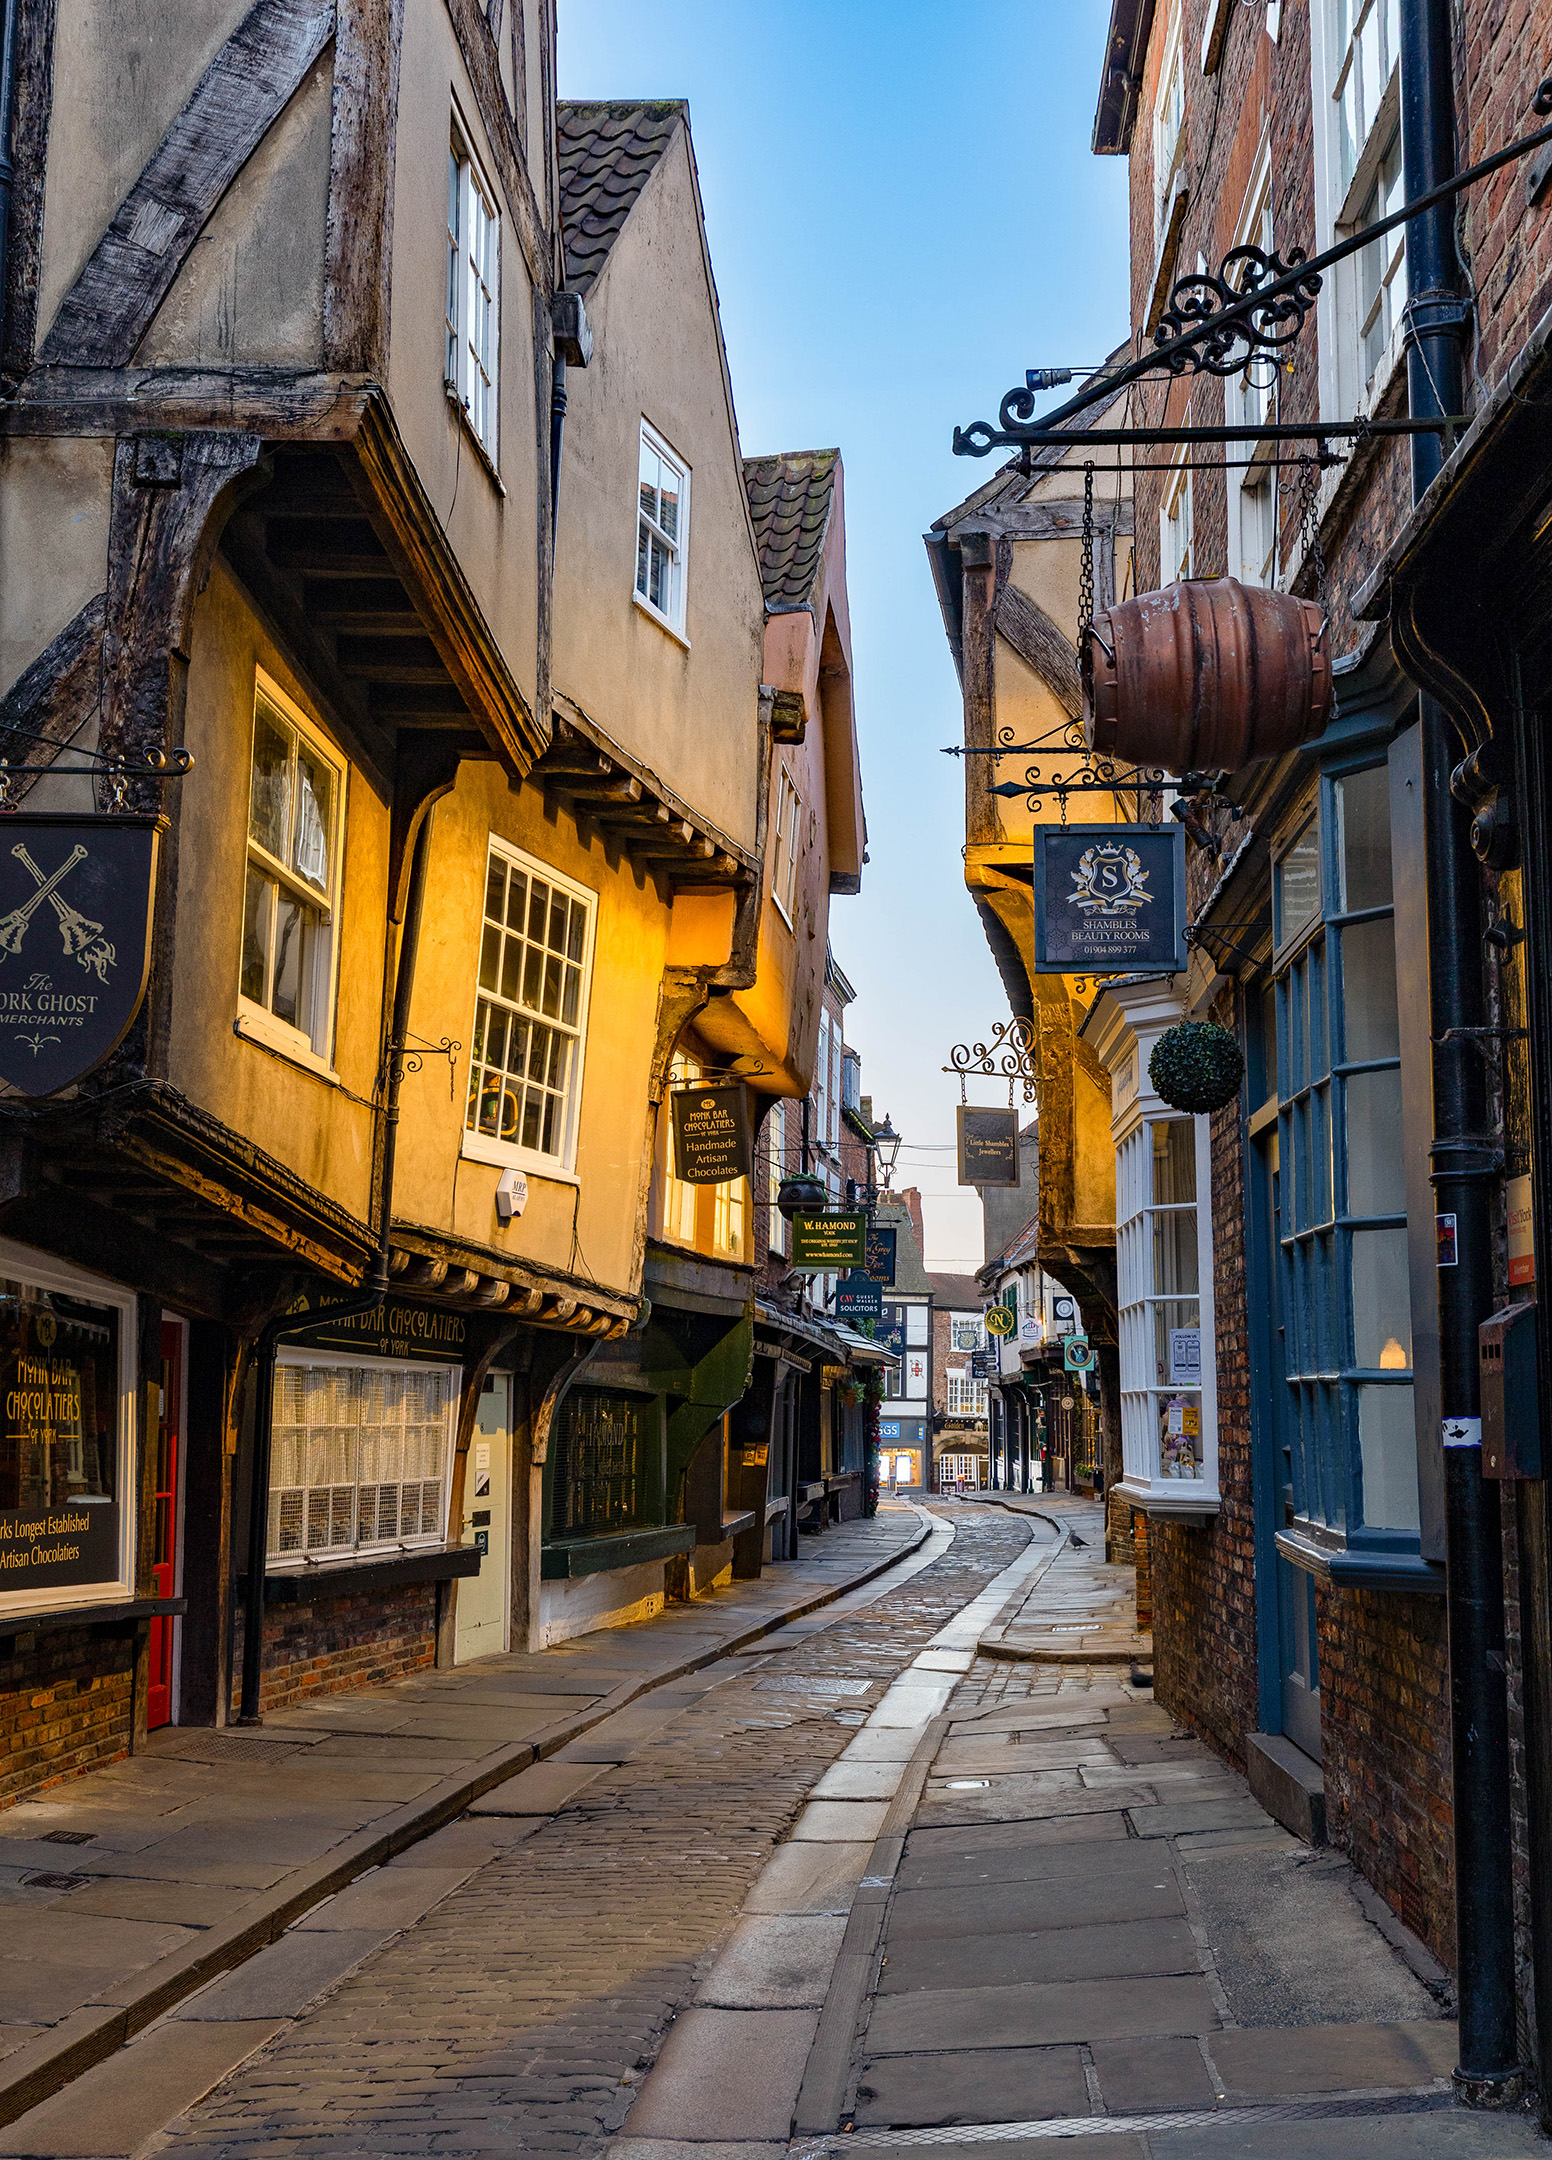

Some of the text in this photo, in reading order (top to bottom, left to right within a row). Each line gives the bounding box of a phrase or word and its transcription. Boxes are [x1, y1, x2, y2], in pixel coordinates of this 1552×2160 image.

[1102, 865, 1118, 888] S
[1083, 920, 1137, 929] SHAMBLES
[1072, 931, 1150, 940] BEAUTY ROOMS
[1084, 945, 1137, 954] 01904 899 377
[23, 973, 53, 991] The
[0, 992, 98, 1013] ORK GHOST
[0, 1014, 84, 1027] MERCHANTS
[690, 1109, 728, 1121] MONK BAR
[684, 1118, 735, 1132] CHOCOLATIERS
[686, 1138, 737, 1152] Handmade
[696, 1154, 728, 1164] Artisan
[687, 1165, 738, 1178] Chocolates
[815, 1221, 856, 1230] HAMOND
[872, 1242, 891, 1255] Grey
[389, 1306, 466, 1343] CHOCOLATIERS
[989, 1313, 1009, 1329] N
[379, 1338, 409, 1356] OF YORK
[18, 1355, 72, 1386] MONK BAR
[6, 1390, 81, 1421] CHOCOLATIERS
[30, 1428, 57, 1445] OF YORK
[0, 1511, 90, 1543] rks Longest Established
[0, 1542, 80, 1570] Artisan Chocolatiers
